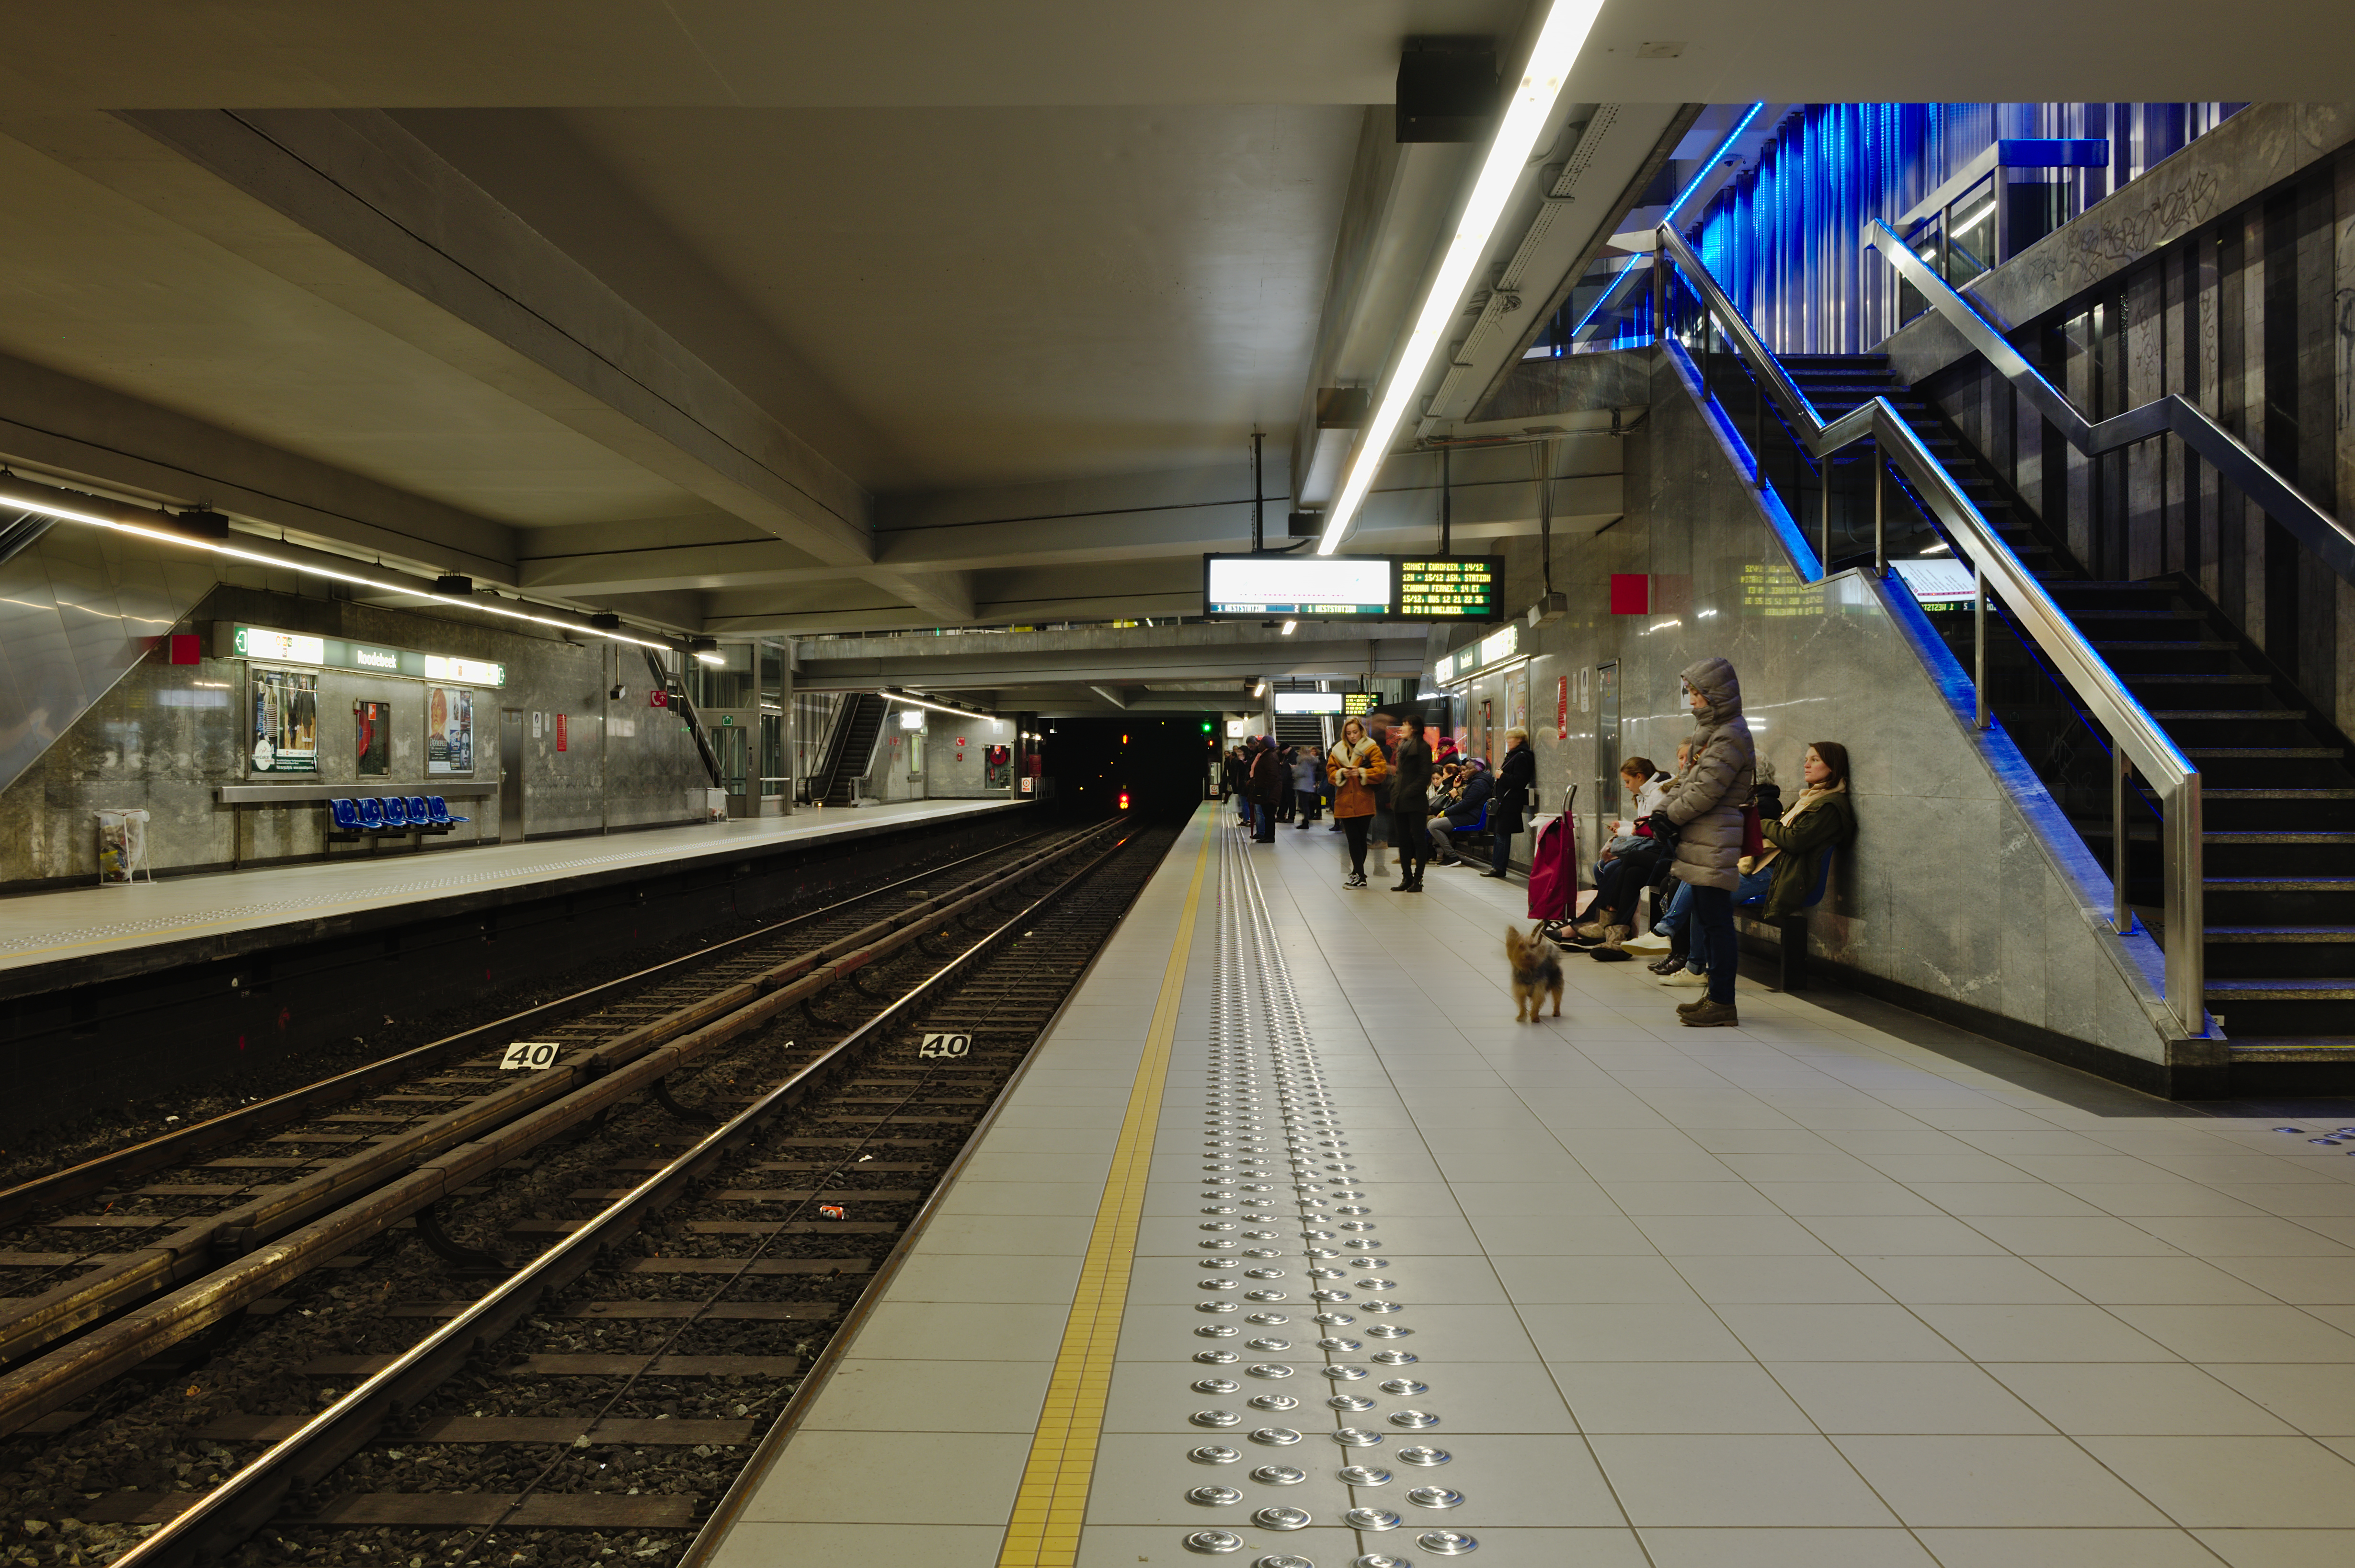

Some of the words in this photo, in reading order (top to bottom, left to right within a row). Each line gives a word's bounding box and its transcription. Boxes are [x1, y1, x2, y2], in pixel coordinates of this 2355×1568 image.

[1428, 563, 1460, 571] EUROPEEN.
[1464, 574, 1491, 582] STATION
[358, 650, 397, 668] Roodebeek
[923, 1035, 968, 1055] 40
[507, 1045, 553, 1065] 40
